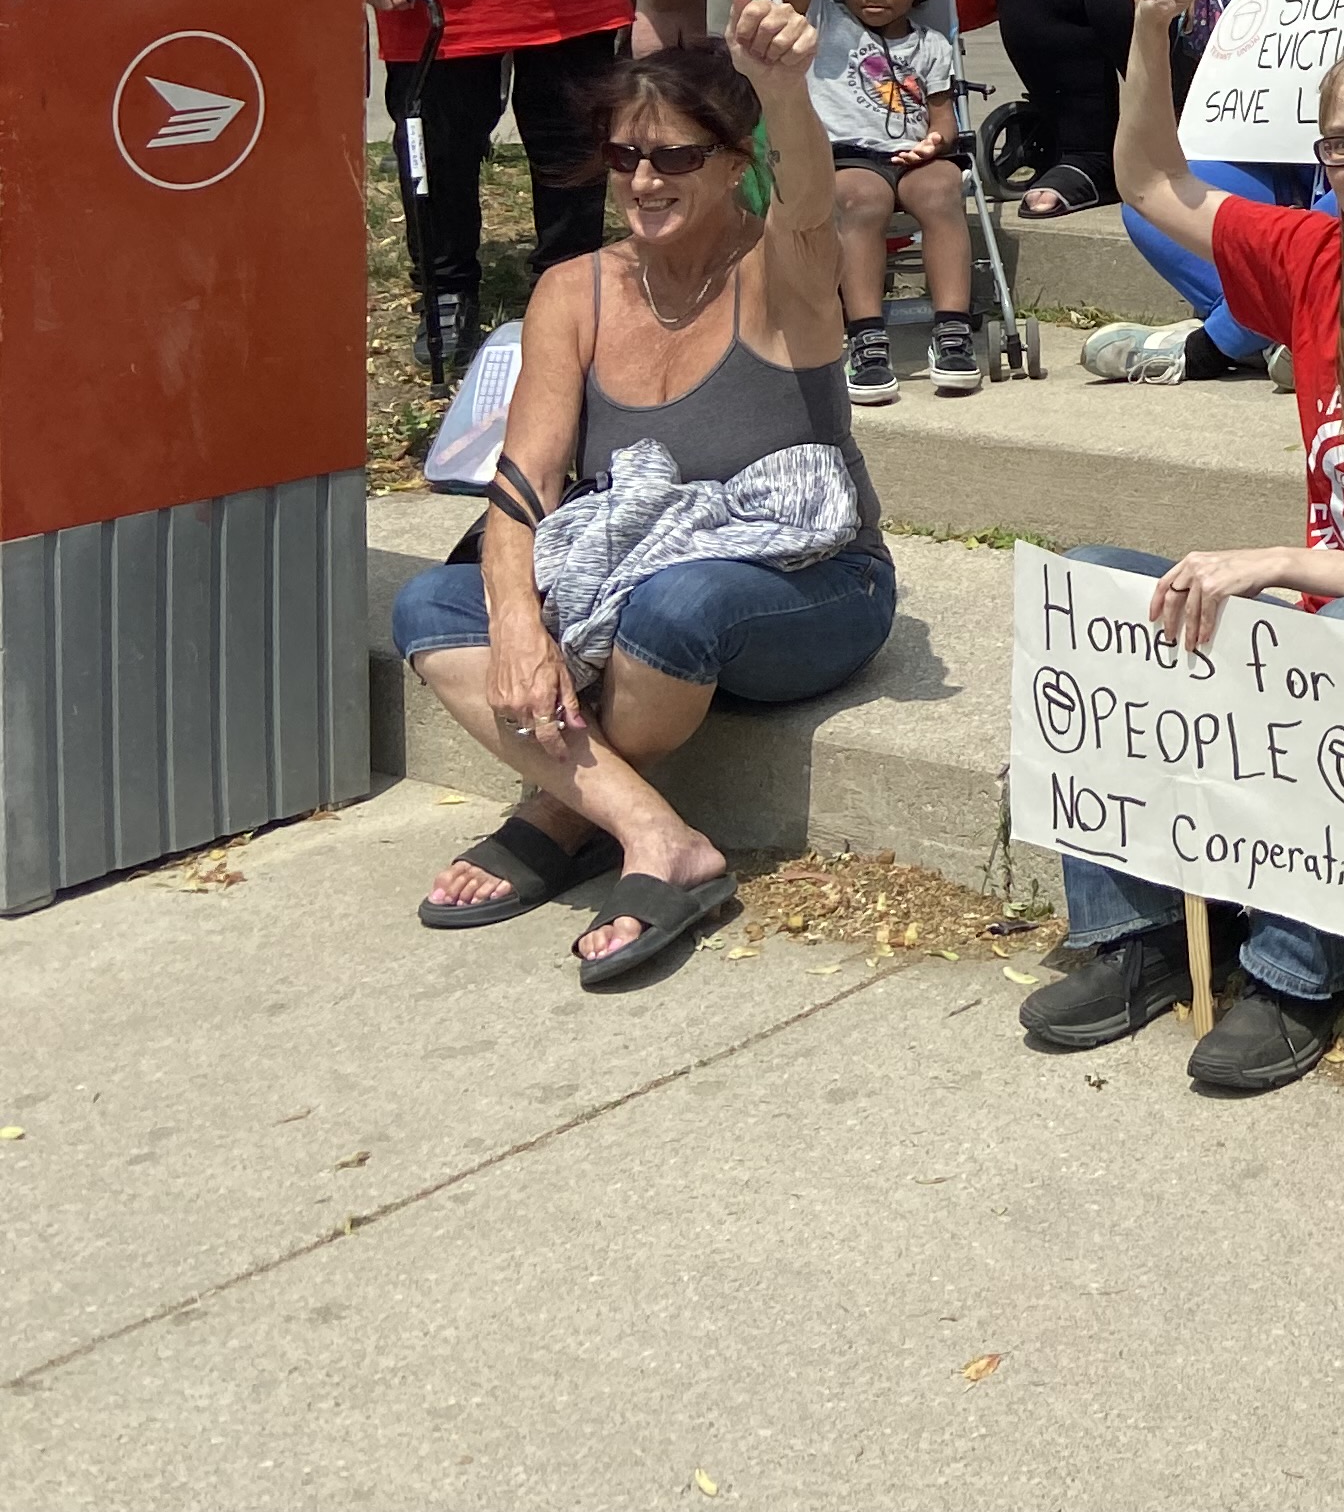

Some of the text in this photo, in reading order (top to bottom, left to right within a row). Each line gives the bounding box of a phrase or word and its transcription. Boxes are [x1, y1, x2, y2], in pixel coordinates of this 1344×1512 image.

[1206, 88, 1269, 123] SAVE
[1246, 619, 1335, 701] for
[1091, 688, 1302, 784] PEOPLE
[1052, 772, 1147, 850] NOT
